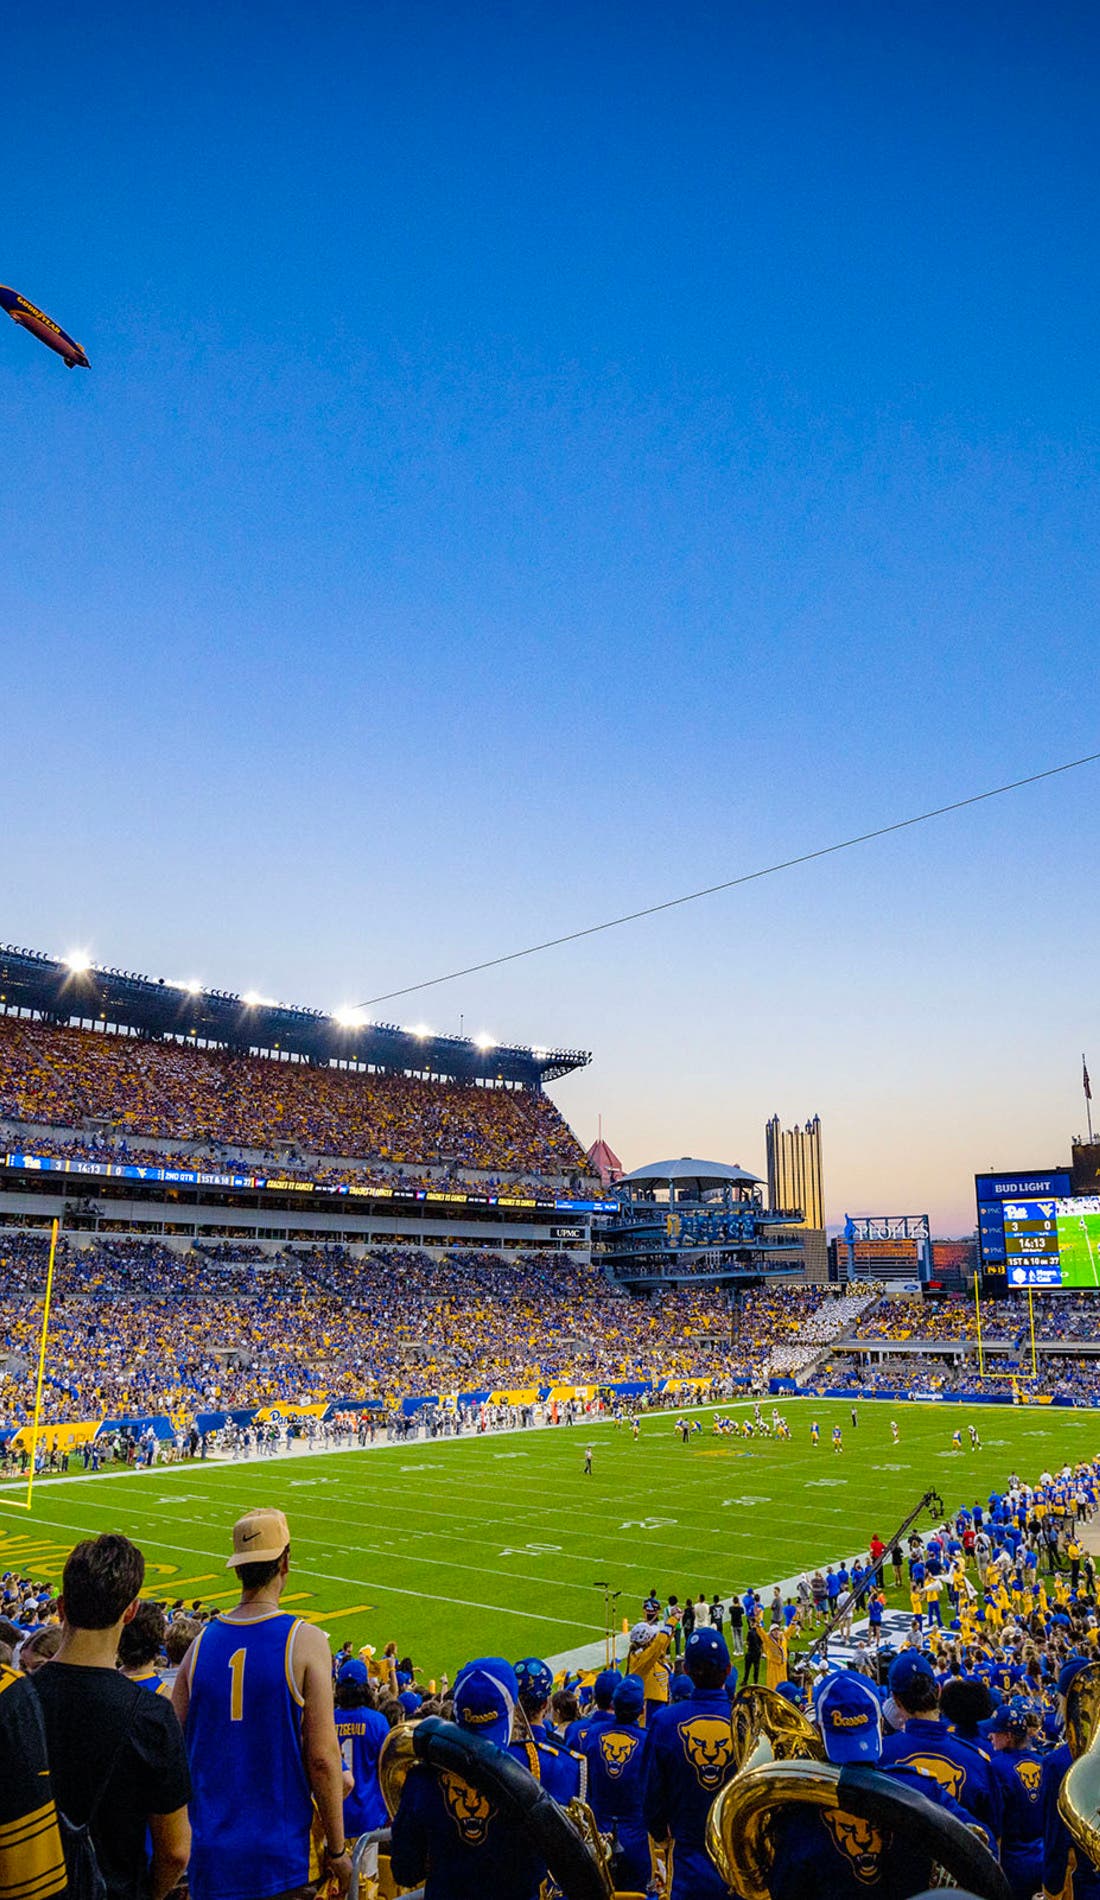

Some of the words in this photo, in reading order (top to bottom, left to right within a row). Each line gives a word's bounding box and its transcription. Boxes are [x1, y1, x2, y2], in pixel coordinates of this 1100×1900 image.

[17, 296, 61, 334] GOODYEAR
[77, 1163, 100, 1174] 14:13
[995, 1183, 1018, 1193] BUD
[1019, 1181, 1051, 1192] LIGHT
[1011, 1221, 1019, 1231] 3
[1043, 1220, 1052, 1230] 0
[556, 1228, 580, 1237] UPMC
[860, 1224, 929, 1240] PEOPLES
[1019, 1238, 1046, 1248] 14:13
[1008, 1257, 1023, 1266] 1ST
[1023, 1257, 1030, 1266] &
[1031, 1257, 1040, 1266] 10
[1049, 1256, 1060, 1265] 37
[618, 1516, 678, 1530] 20
[499, 1543, 563, 1557] 10
[228, 1647, 247, 1721] 1
[335, 1722, 366, 1737] TZGERALD
